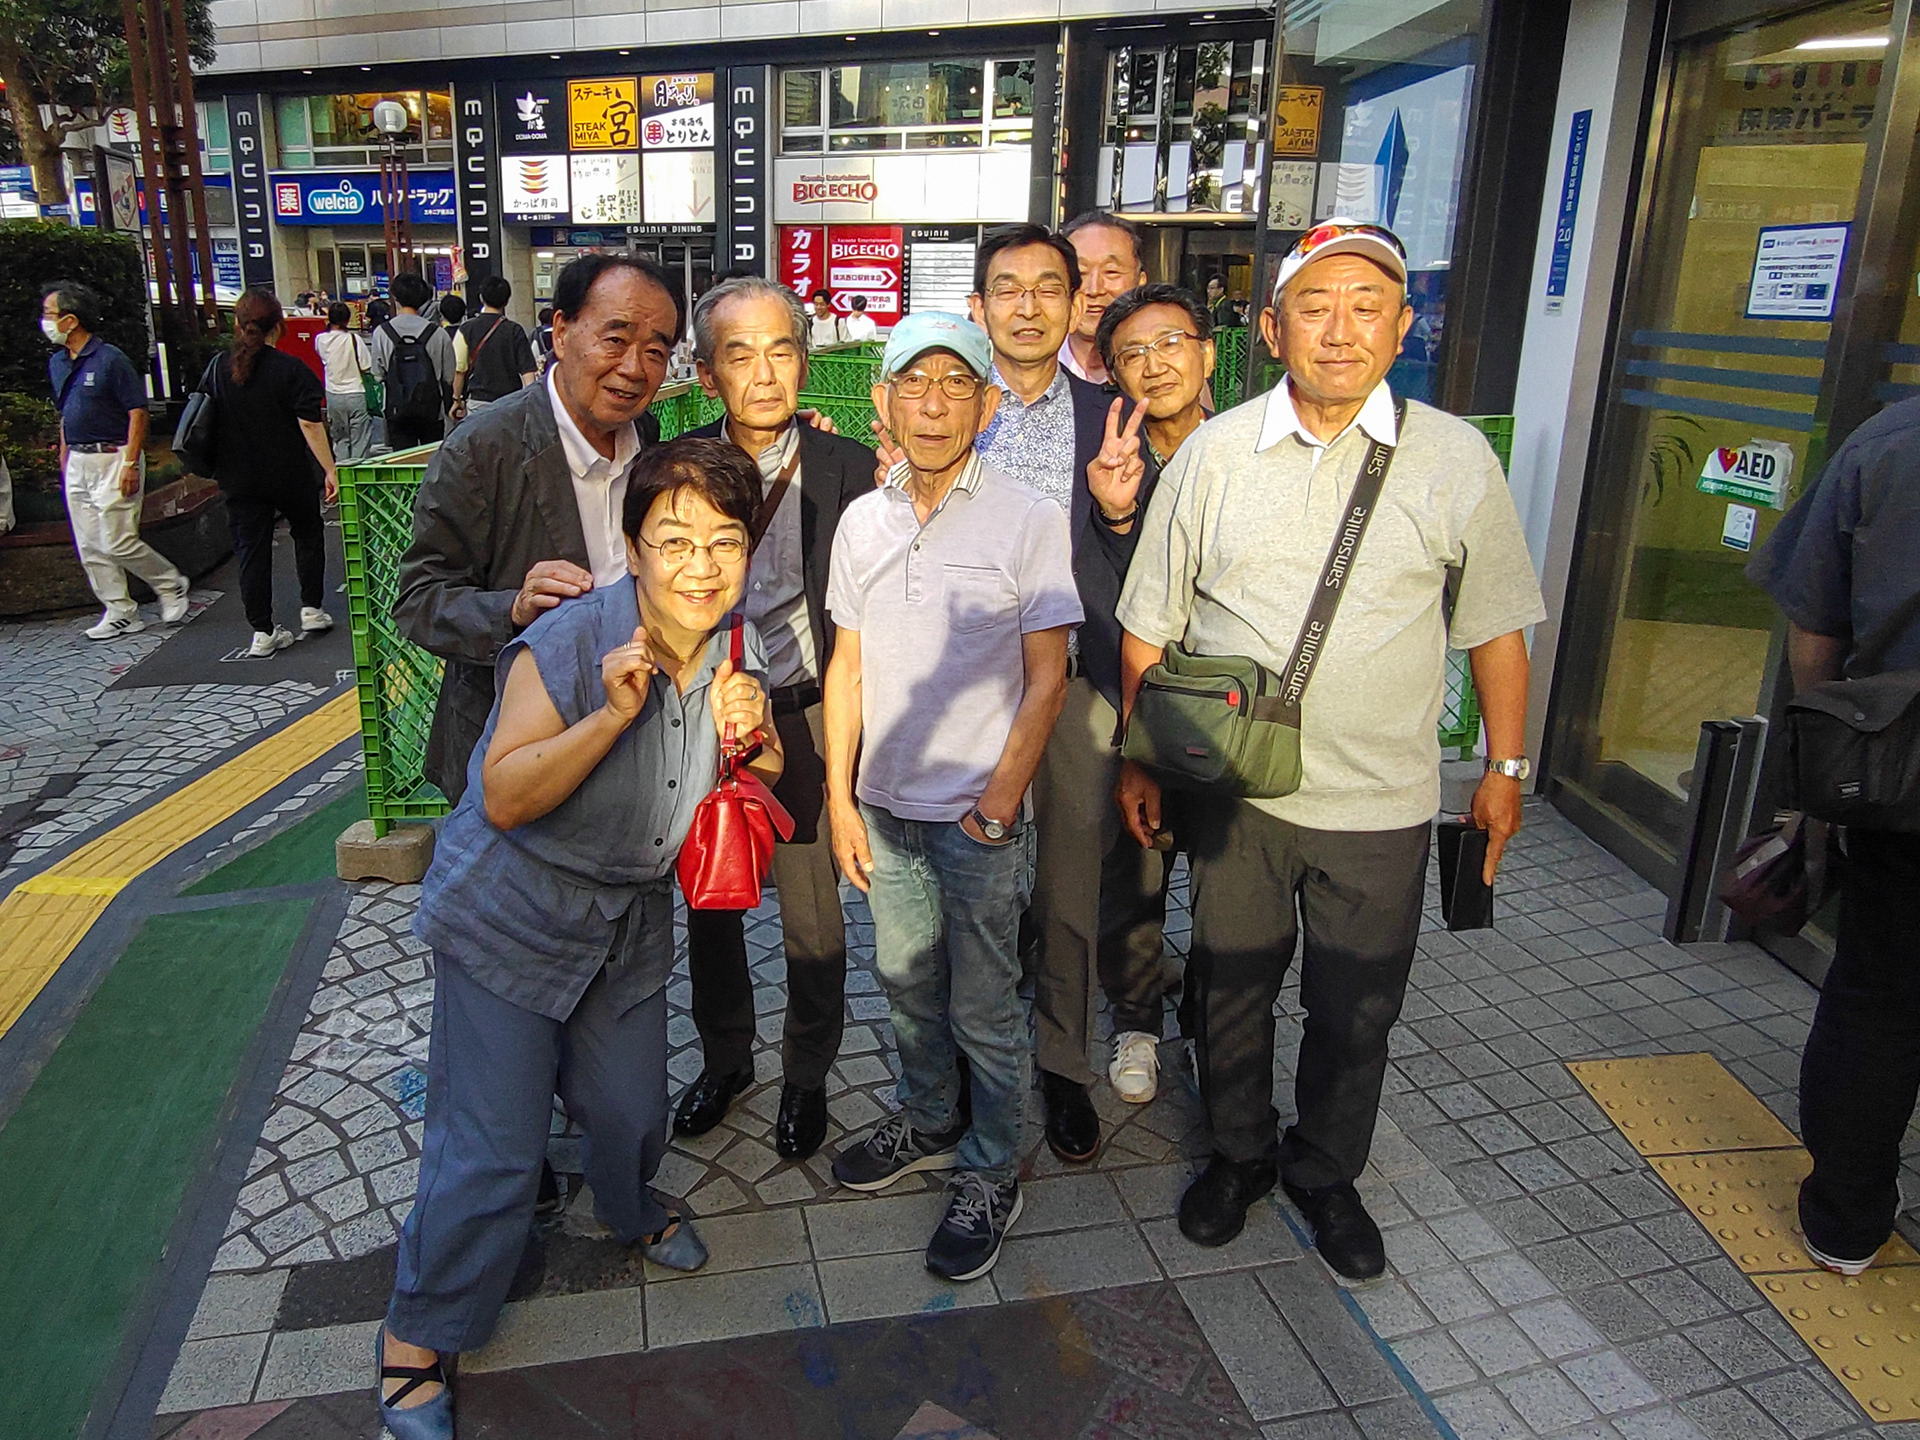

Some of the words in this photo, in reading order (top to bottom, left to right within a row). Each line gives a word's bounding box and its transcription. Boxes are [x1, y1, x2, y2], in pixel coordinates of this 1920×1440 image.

[573, 86, 613, 102] ステーキ
[574, 122, 607, 131] STEAK
[602, 87, 636, 147] 宮
[574, 131, 600, 141] MIYA
[647, 123, 662, 142] 串
[666, 129, 712, 143] とりとん
[464, 99, 491, 260] EQUINIA
[733, 86, 755, 261] EQUINIA
[236, 110, 265, 259] EQUINIA
[793, 183, 827, 202] BIG
[828, 182, 878, 201] ECHO
[313, 193, 358, 210] welcia
[672, 224, 703, 233] DINING
[831, 244, 858, 259] BIG
[859, 244, 900, 258] ECHO
[791, 229, 813, 298] カラオ
[1734, 450, 1776, 480] AED
[1325, 506, 1368, 590] Samsonite
